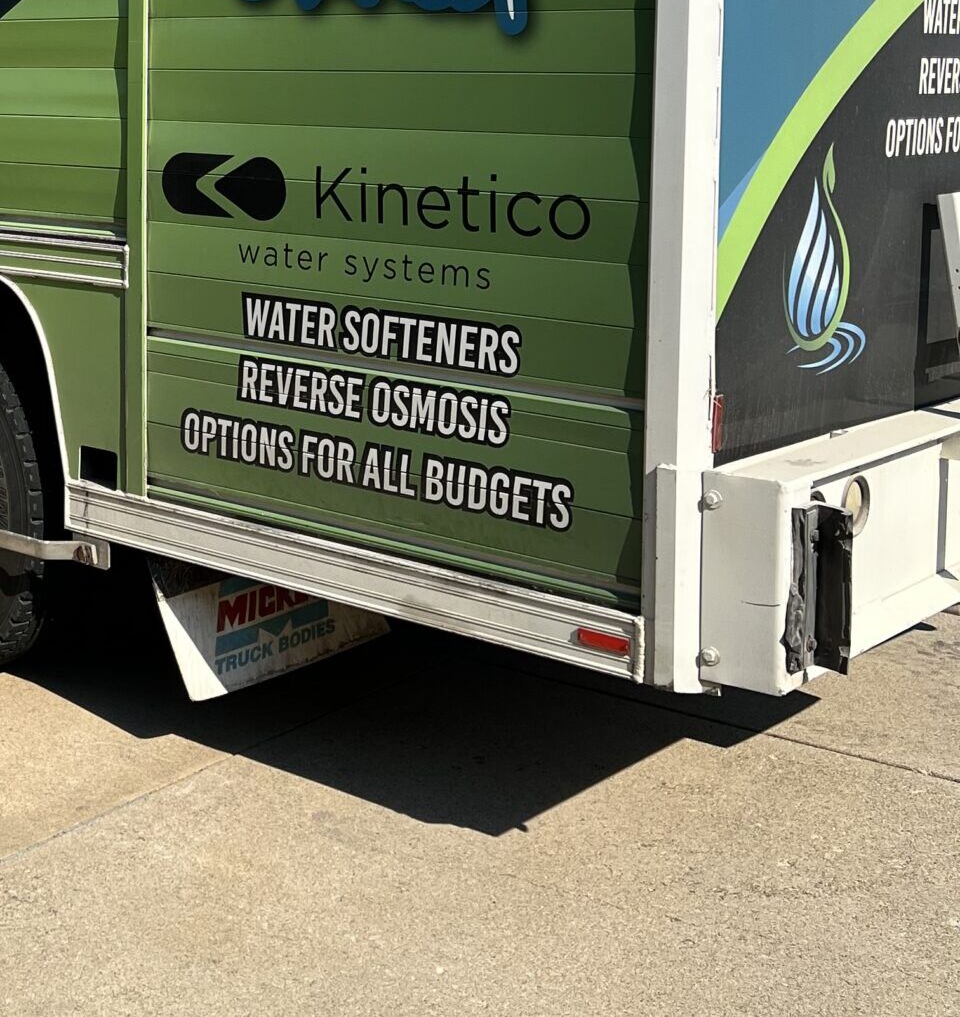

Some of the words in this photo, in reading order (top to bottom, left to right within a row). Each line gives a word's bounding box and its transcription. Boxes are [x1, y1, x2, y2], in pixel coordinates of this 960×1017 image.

[885, 116, 944, 158] OPTIONS
[314, 165, 591, 241] Kinetico
[238, 242, 329, 273] water
[344, 252, 492, 291] systems
[245, 296, 335, 348] WATER
[342, 309, 521, 376] SOFTENERS
[241, 360, 364, 420] REVERSE
[372, 381, 510, 445] OSMOSIS
[183, 412, 294, 471] OPTIONS
[302, 434, 355, 483] FOR
[362, 447, 416, 498] ALL
[424, 458, 572, 529] BUDGETS
[216, 584, 320, 634] MICK
[214, 641, 273, 675] TRUCK
[278, 618, 336, 655] BODIES
